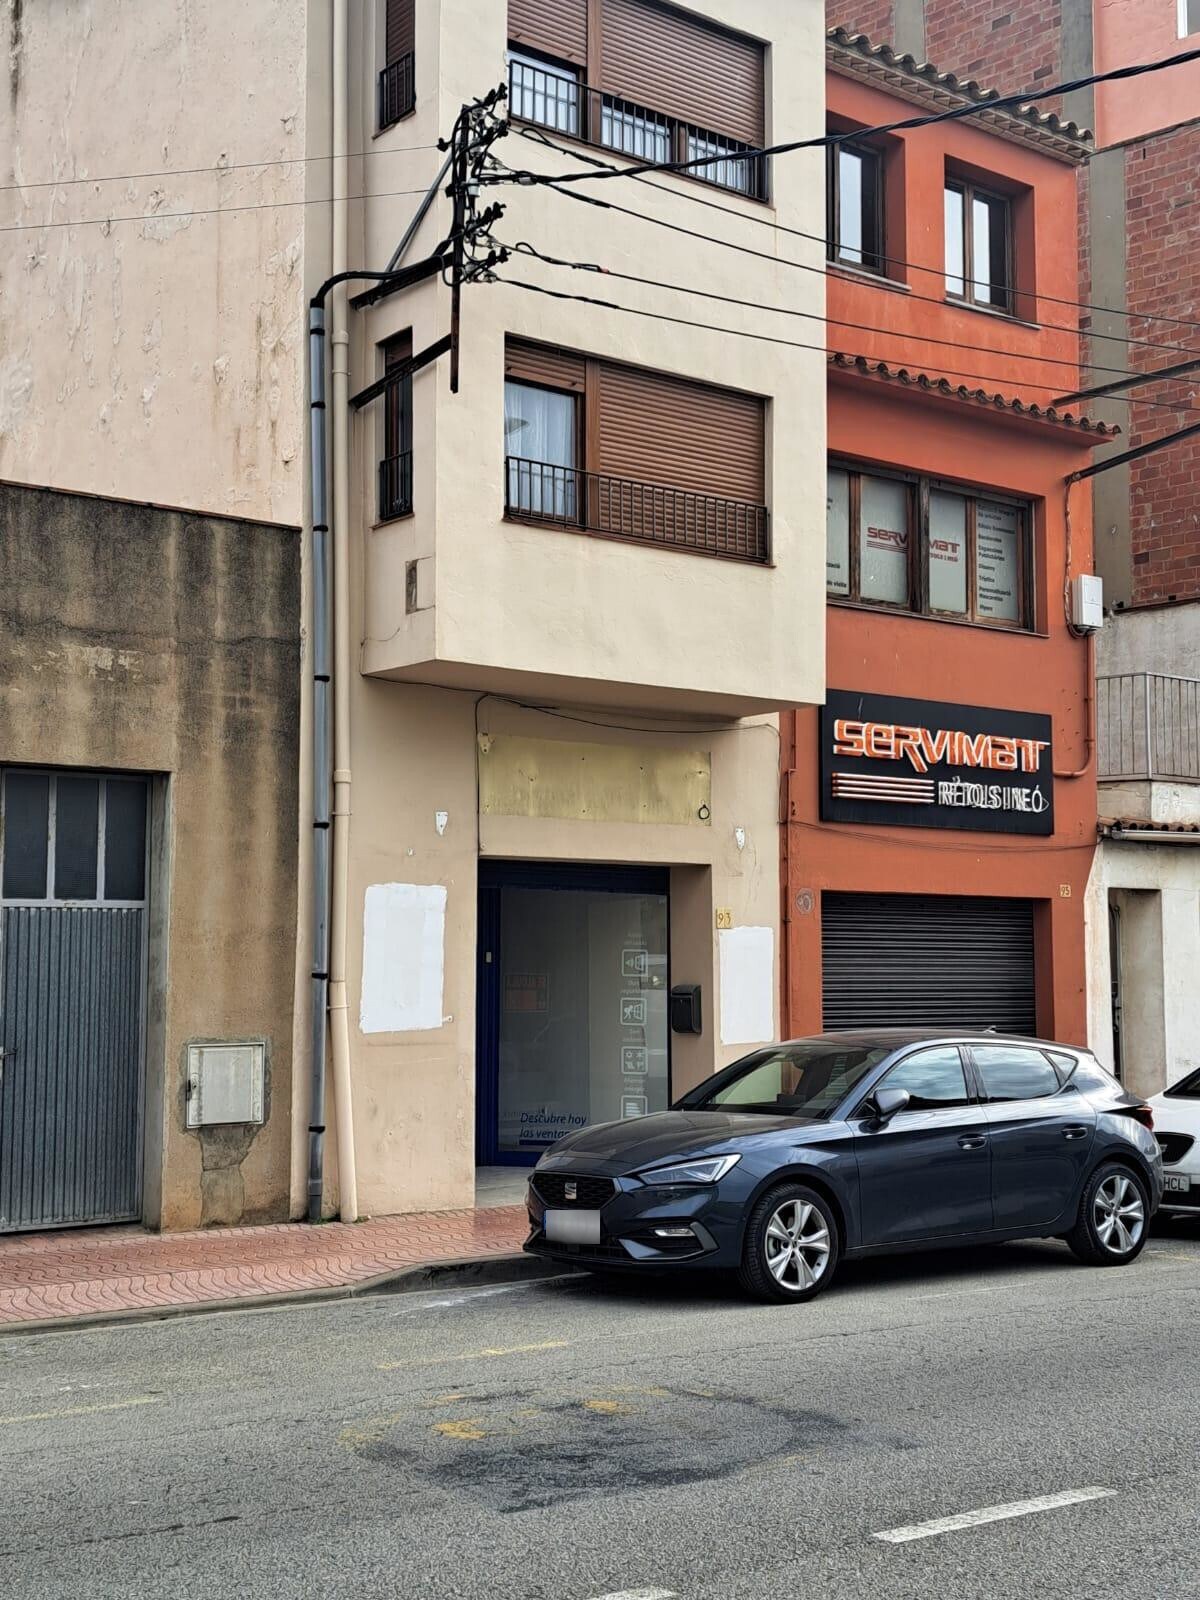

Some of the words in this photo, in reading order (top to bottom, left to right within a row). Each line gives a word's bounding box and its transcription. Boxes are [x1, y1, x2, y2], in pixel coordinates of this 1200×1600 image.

[718, 911, 731, 926] 93
[520, 1112, 567, 1124] Descubre
[568, 1113, 587, 1127] hoy
[520, 1127, 534, 1139] las
